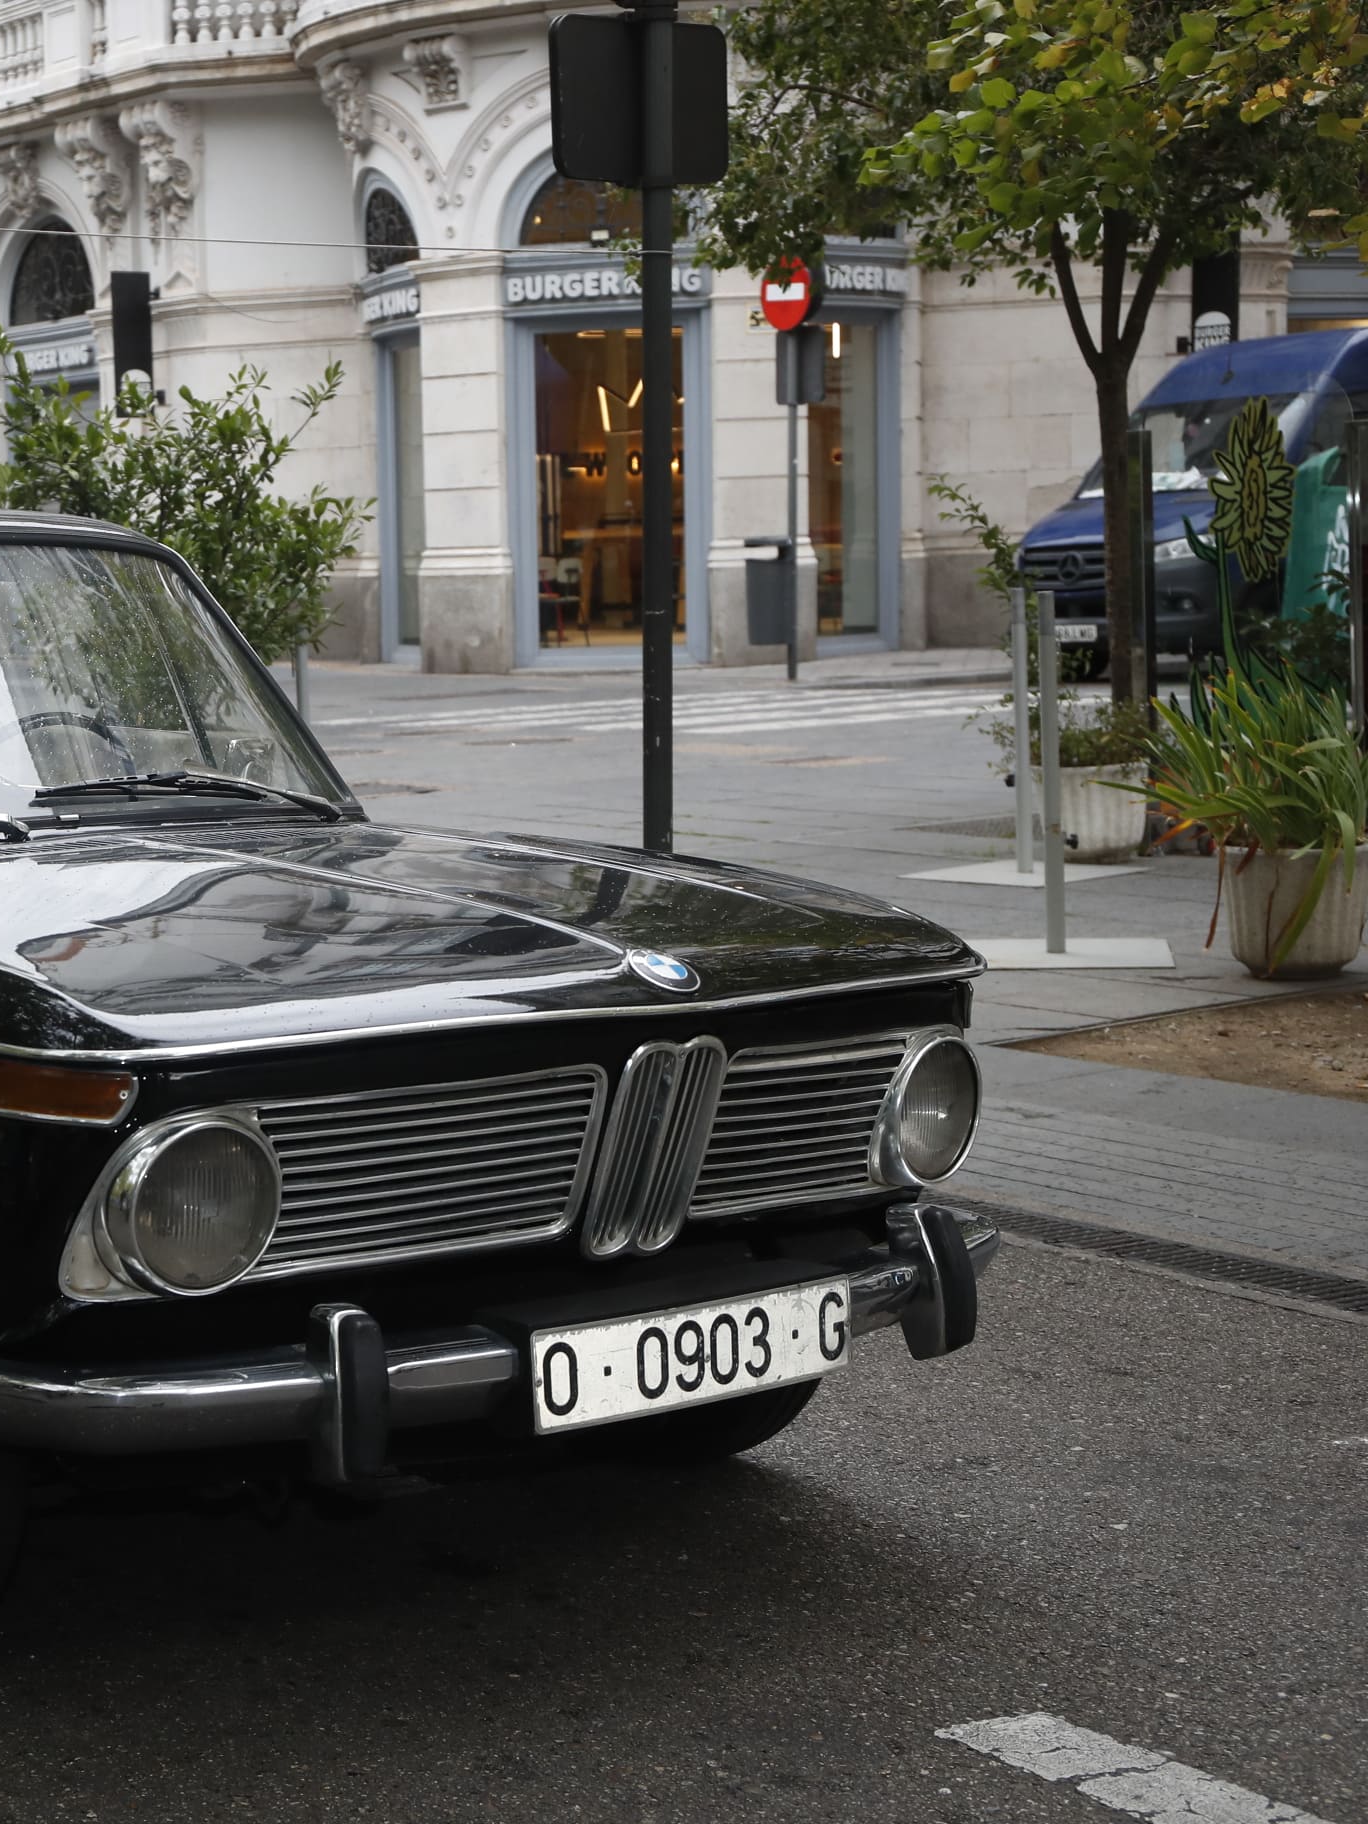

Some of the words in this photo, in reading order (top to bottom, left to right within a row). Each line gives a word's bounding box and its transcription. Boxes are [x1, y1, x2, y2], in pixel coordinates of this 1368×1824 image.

[507, 271, 620, 303] BURGER
[636, 1306, 772, 1400] 0903
[818, 1291, 845, 1361] G
